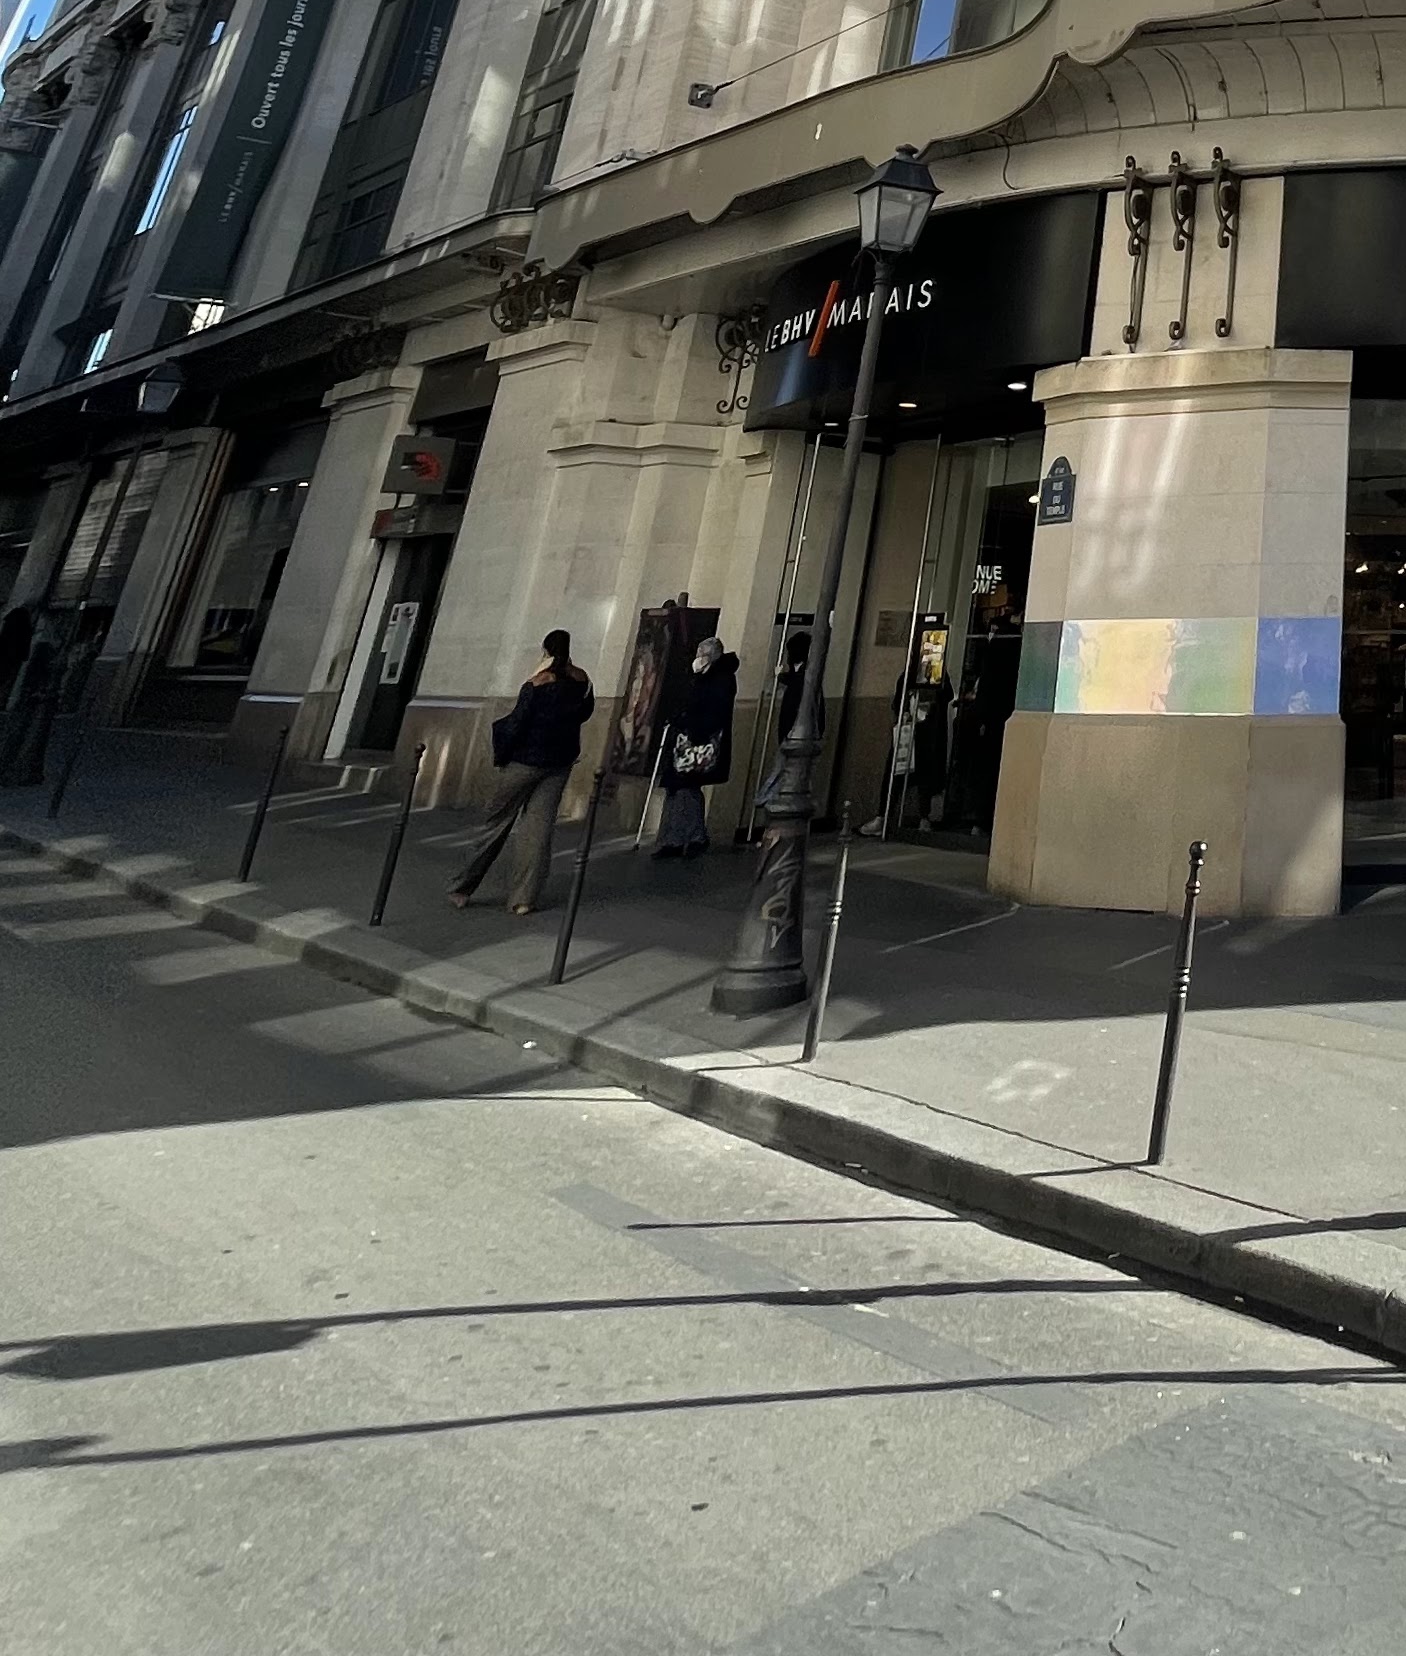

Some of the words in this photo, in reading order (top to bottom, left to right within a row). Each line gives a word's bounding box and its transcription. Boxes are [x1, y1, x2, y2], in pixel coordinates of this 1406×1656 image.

[279, 28, 298, 47] les
[270, 50, 292, 78] tous
[251, 82, 280, 129] Ouvert
[976, 565, 1002, 581] NUE
